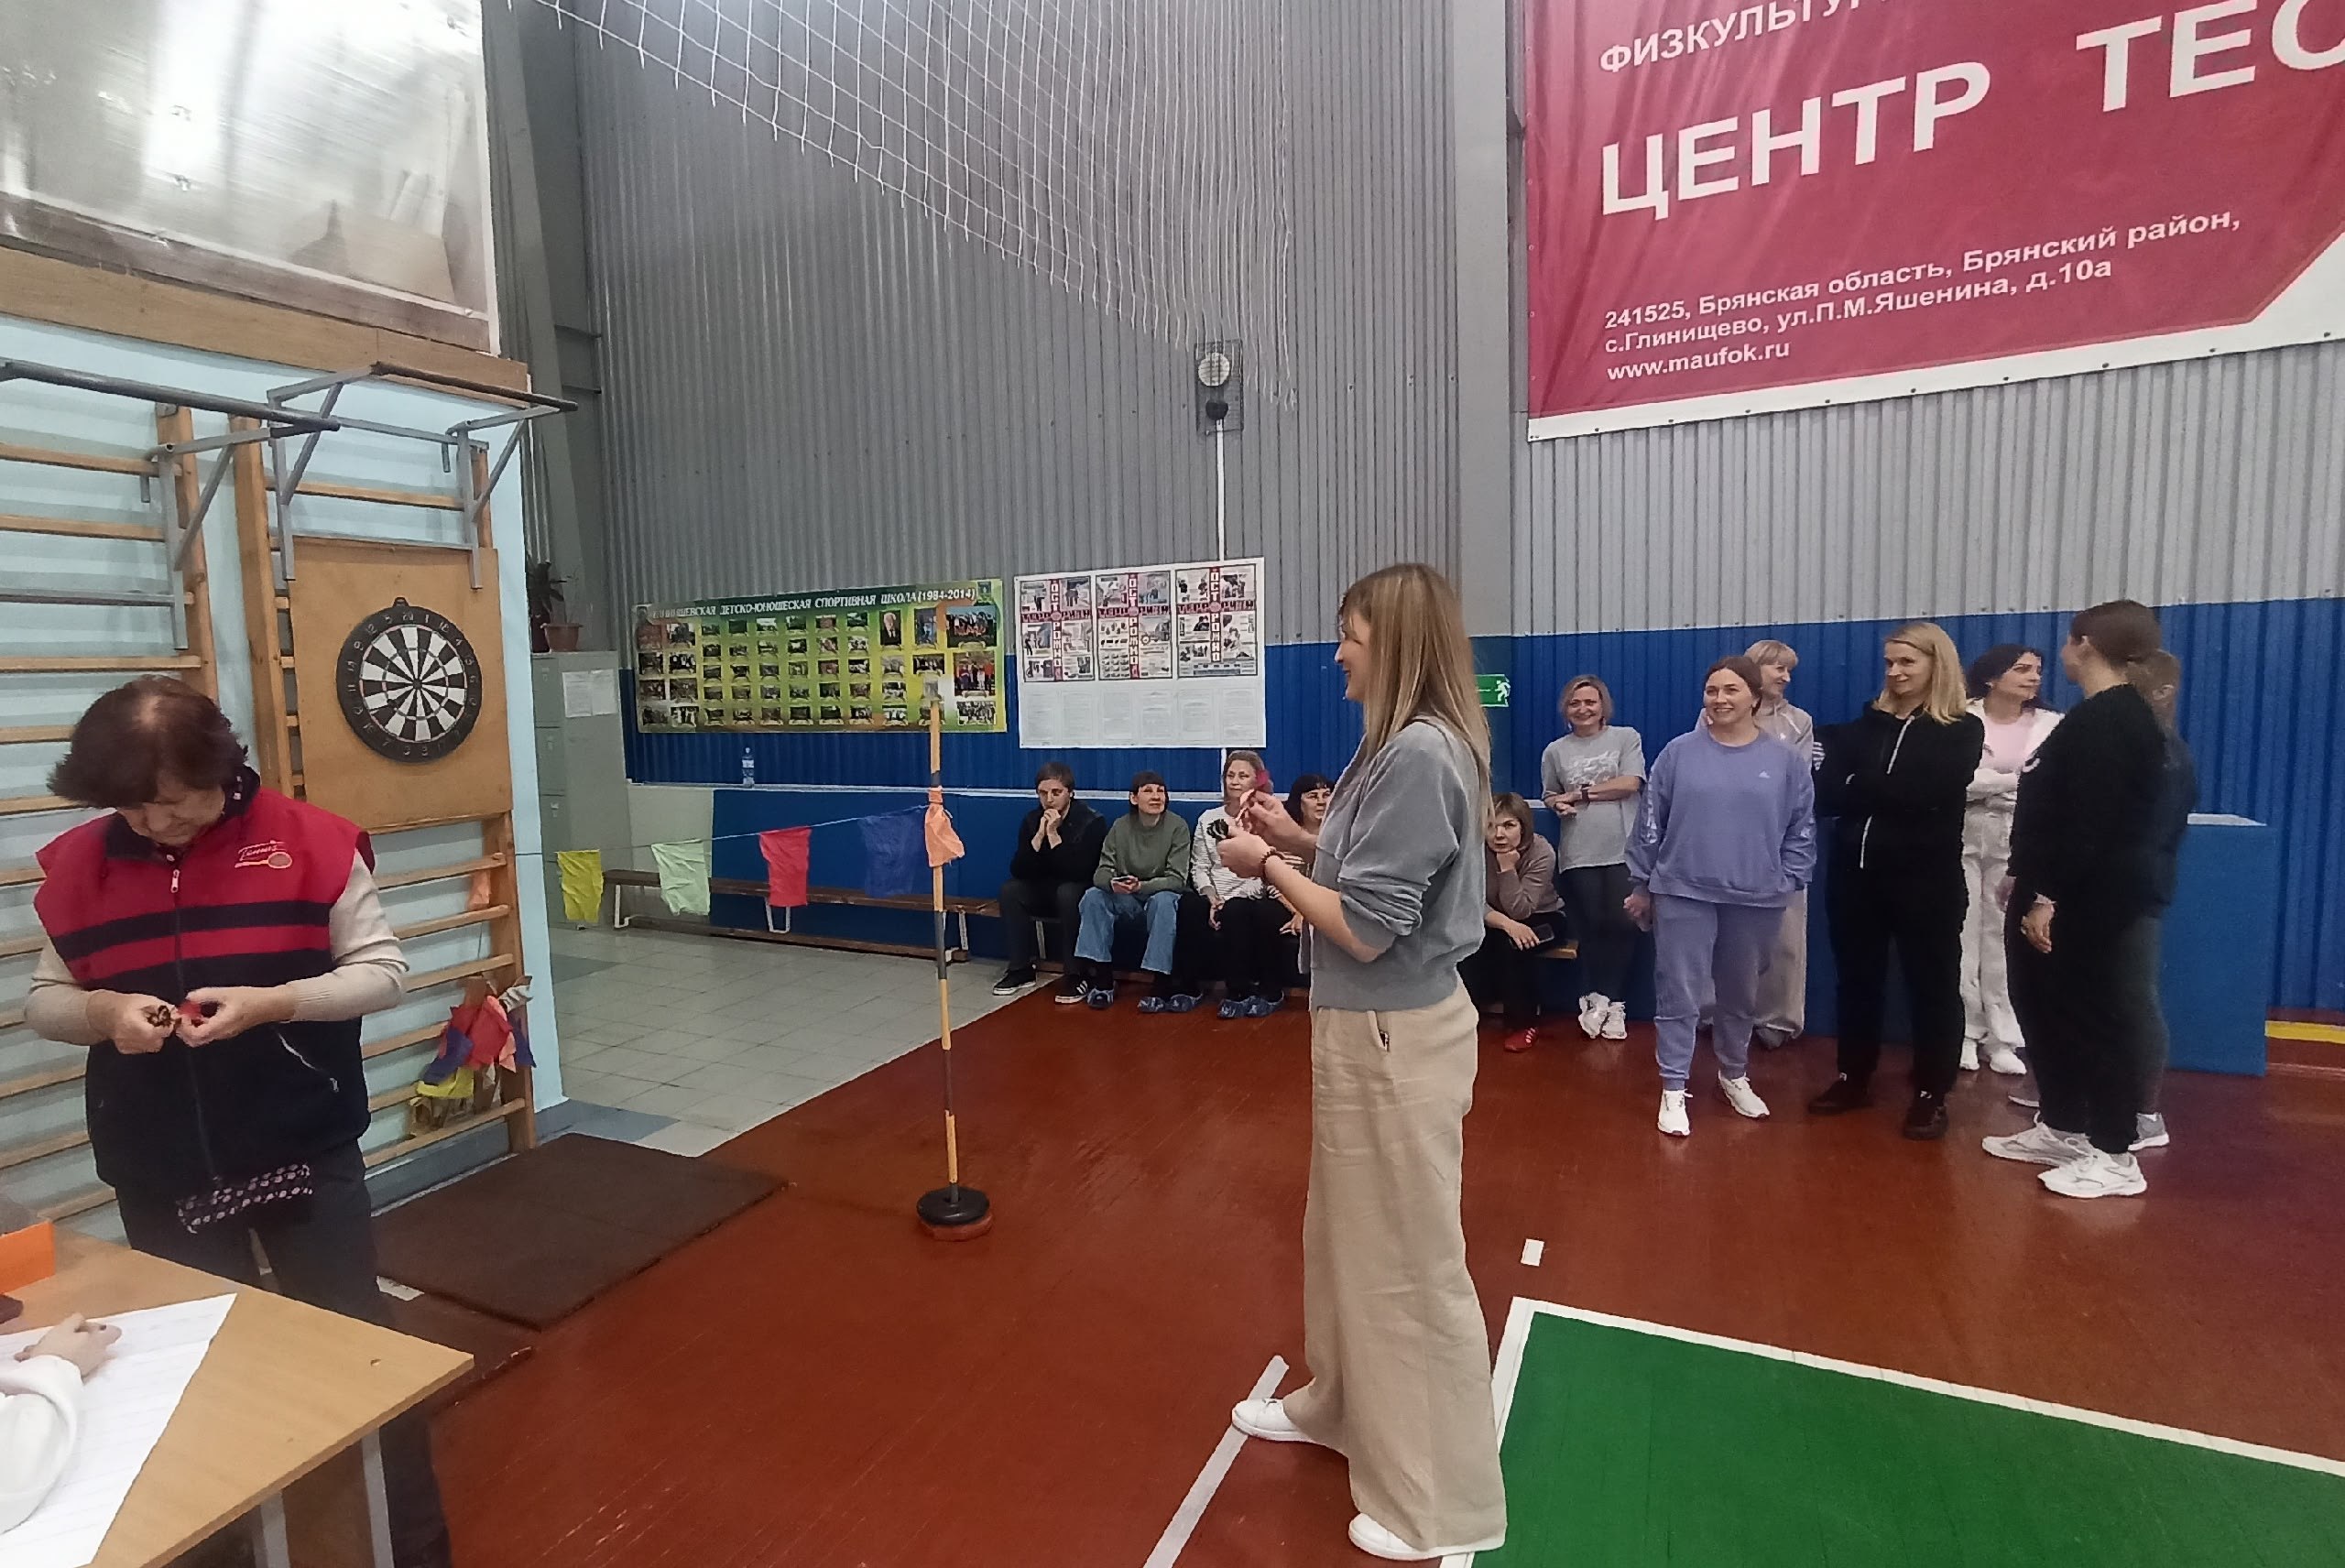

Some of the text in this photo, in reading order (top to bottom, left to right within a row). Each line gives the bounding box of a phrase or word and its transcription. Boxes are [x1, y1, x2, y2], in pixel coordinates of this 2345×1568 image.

[1601, 61, 1991, 221] ЦЕНТР
[1605, 211, 2240, 329] 241525, Брянская область, Брянский район,
[1605, 317, 1770, 353] с.Глинищево,
[2026, 259, 2111, 292] д.10а
[1608, 342, 1790, 380] www.maufok.ru
[814, 594, 877, 608] СПОРТИВНАЯ
